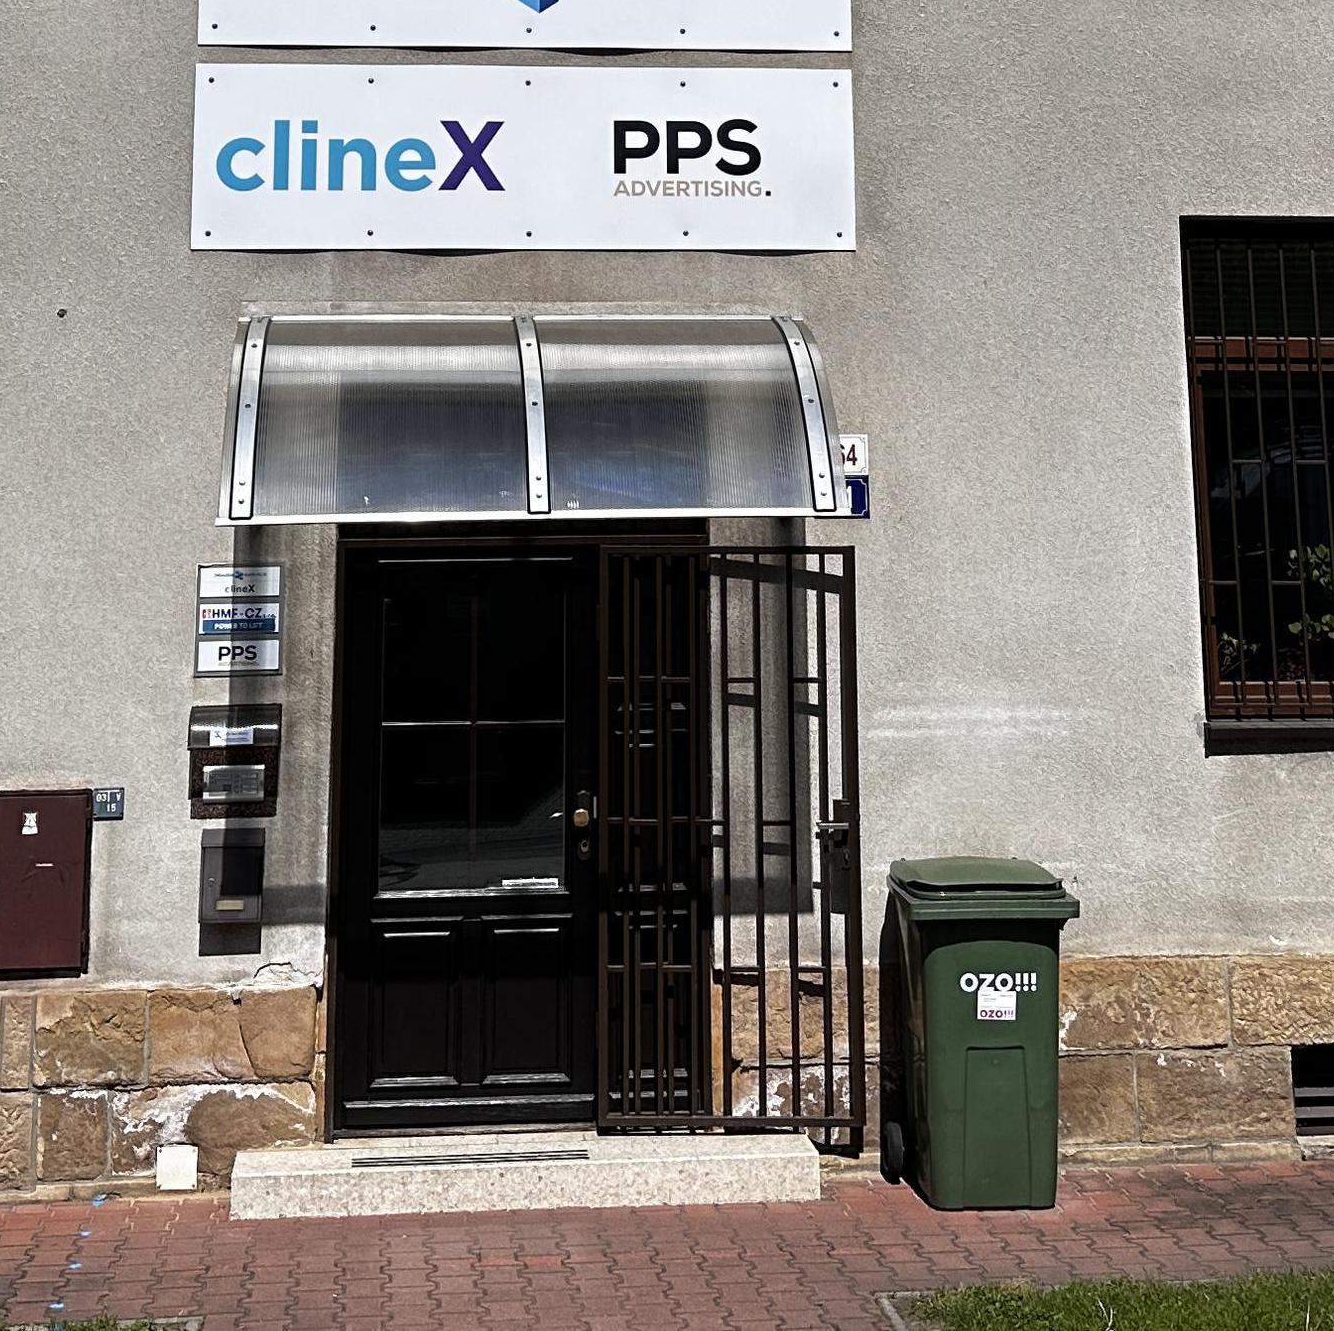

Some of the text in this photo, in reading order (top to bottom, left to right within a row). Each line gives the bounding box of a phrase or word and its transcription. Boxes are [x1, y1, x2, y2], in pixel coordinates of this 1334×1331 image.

[216, 119, 505, 191] clineX
[613, 118, 762, 176] PPS
[225, 584, 255, 593] clineX
[218, 645, 257, 661] PPS
[959, 972, 1037, 993] OZO!!!
[979, 1009, 1014, 1019] OZO!!!
